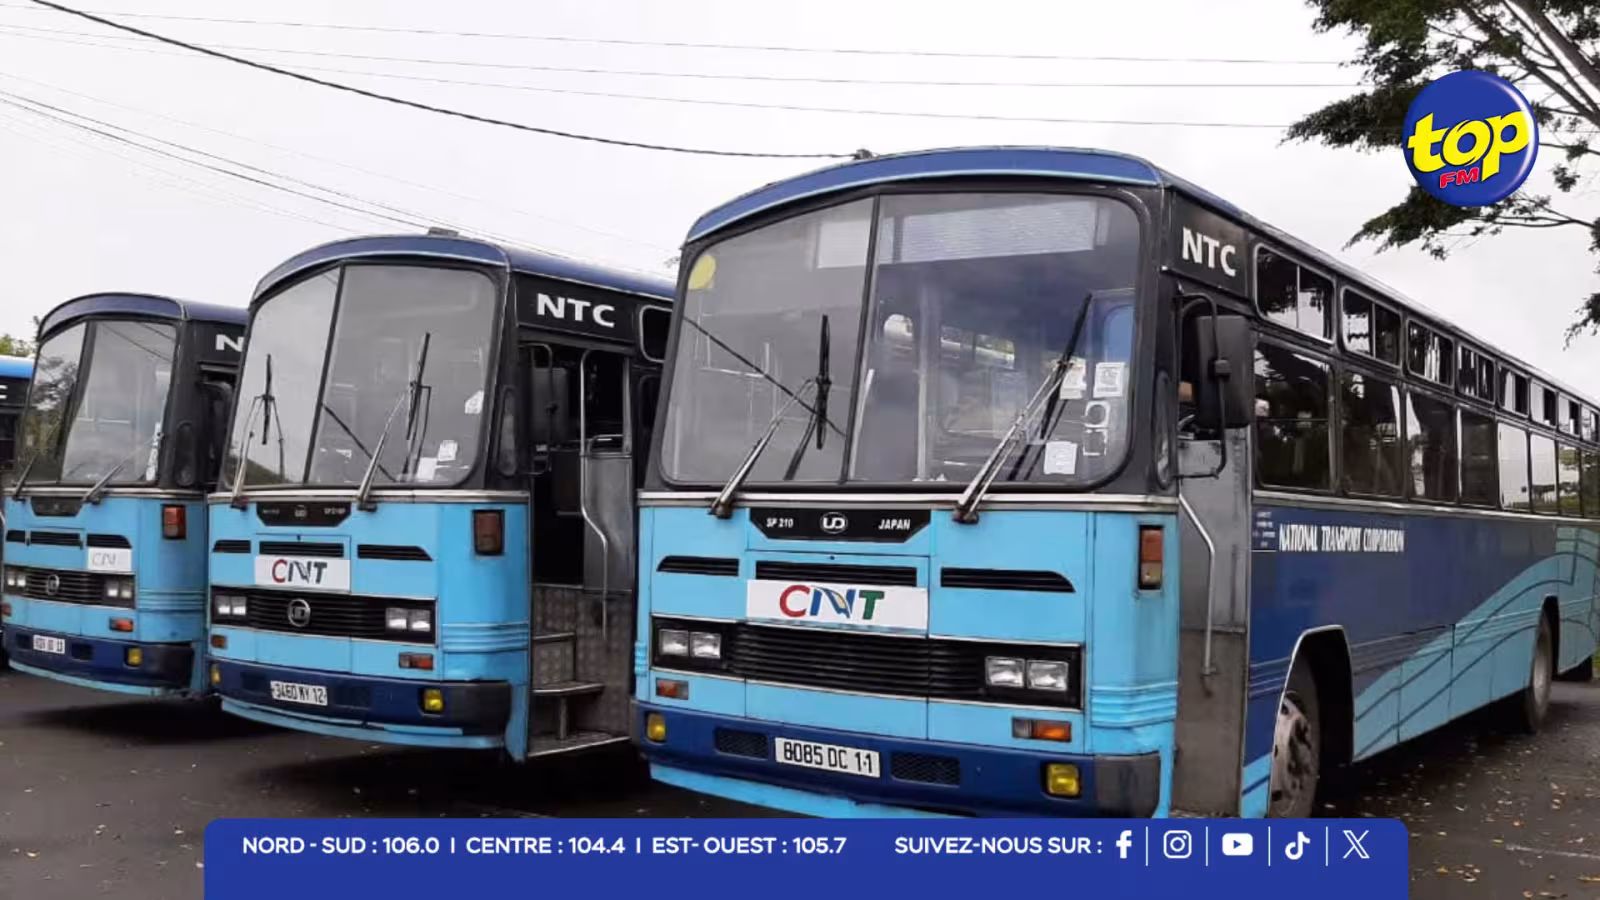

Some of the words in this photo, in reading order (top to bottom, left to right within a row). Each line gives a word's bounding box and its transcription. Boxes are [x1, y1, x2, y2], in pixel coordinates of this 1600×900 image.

[1182, 226, 1236, 277] NTC
[537, 293, 615, 328] NTC
[766, 517, 777, 528] SP
[779, 518, 794, 529] 210
[822, 517, 846, 530] UD
[878, 519, 911, 531] JAPAN
[1279, 523, 1318, 552] NATIONAL
[1321, 525, 1362, 552] TRANSPORT
[1363, 528, 1405, 553] CORPORATION
[272, 559, 328, 584] CNT
[779, 584, 886, 620] CNT
[827, 747, 849, 770] DC
